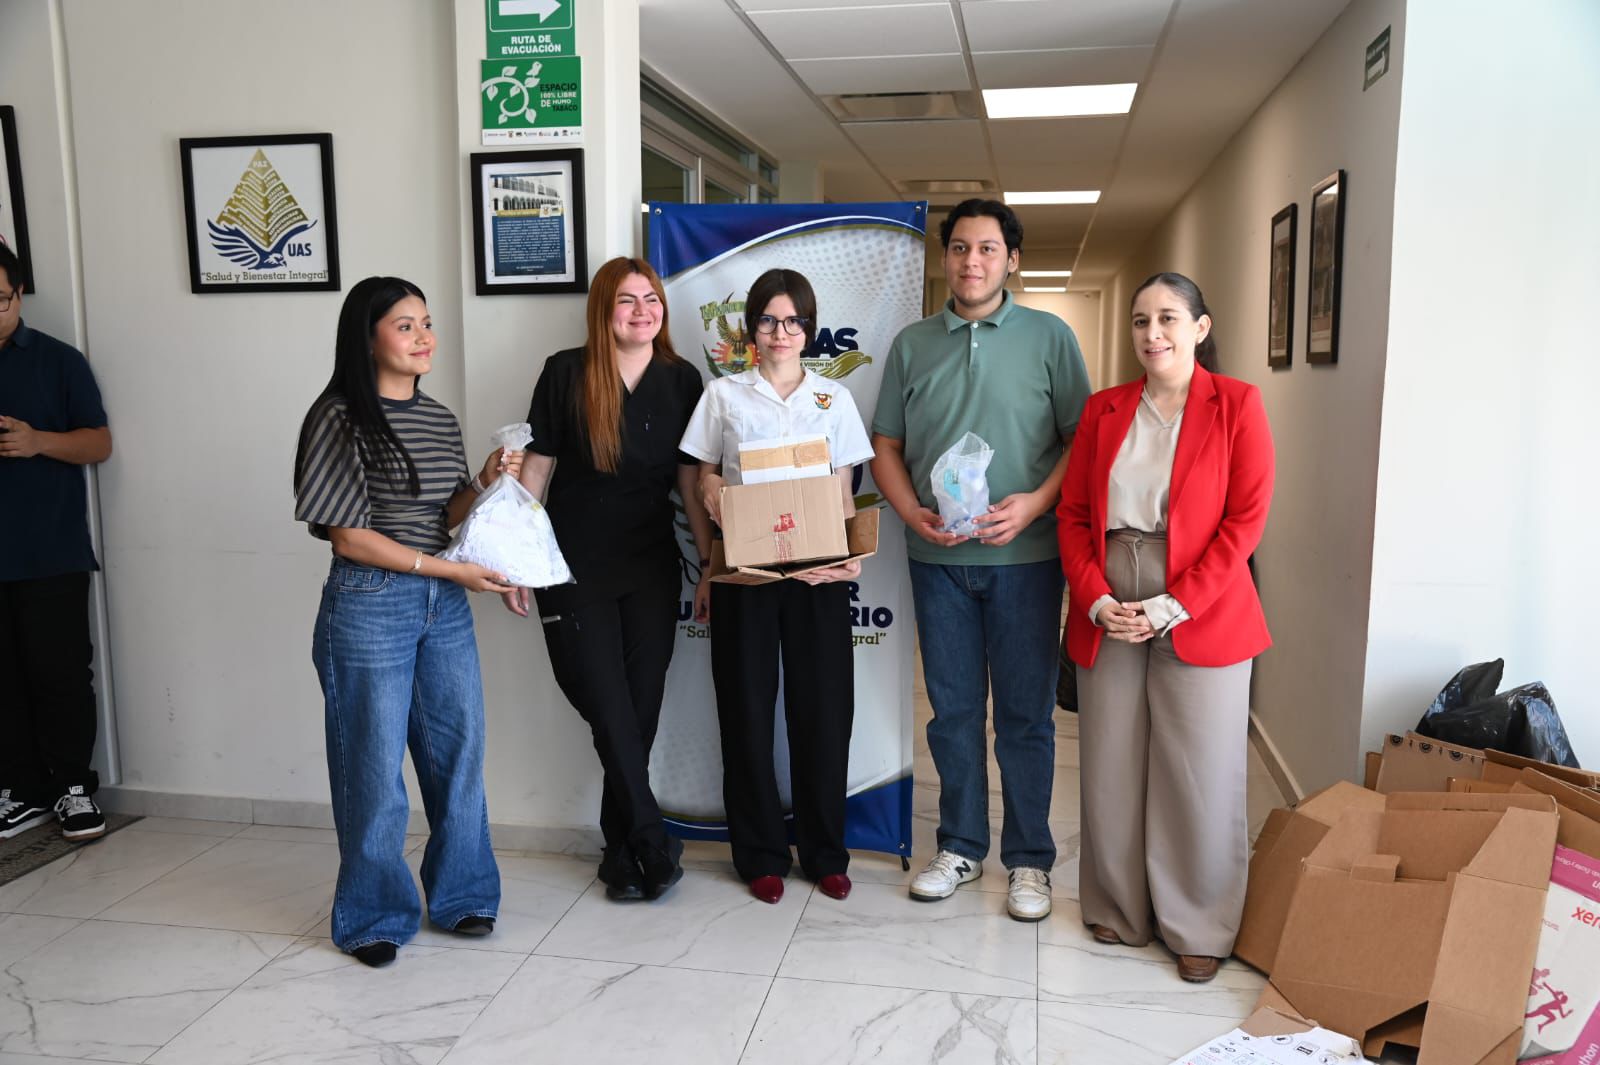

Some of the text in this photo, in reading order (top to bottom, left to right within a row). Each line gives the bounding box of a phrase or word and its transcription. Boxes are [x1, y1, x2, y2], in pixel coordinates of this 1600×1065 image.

[511, 35, 551, 44] RUTA DE
[501, 43, 561, 54] EVACUACIÓN
[540, 82, 577, 91] ESPACIO
[541, 99, 551, 107] DE
[287, 243, 312, 257] UAS
[242, 271, 286, 281] Bienestar
[803, 327, 859, 358] AS
[680, 625, 711, 639] “Sal
[1571, 905, 1600, 929] xer
